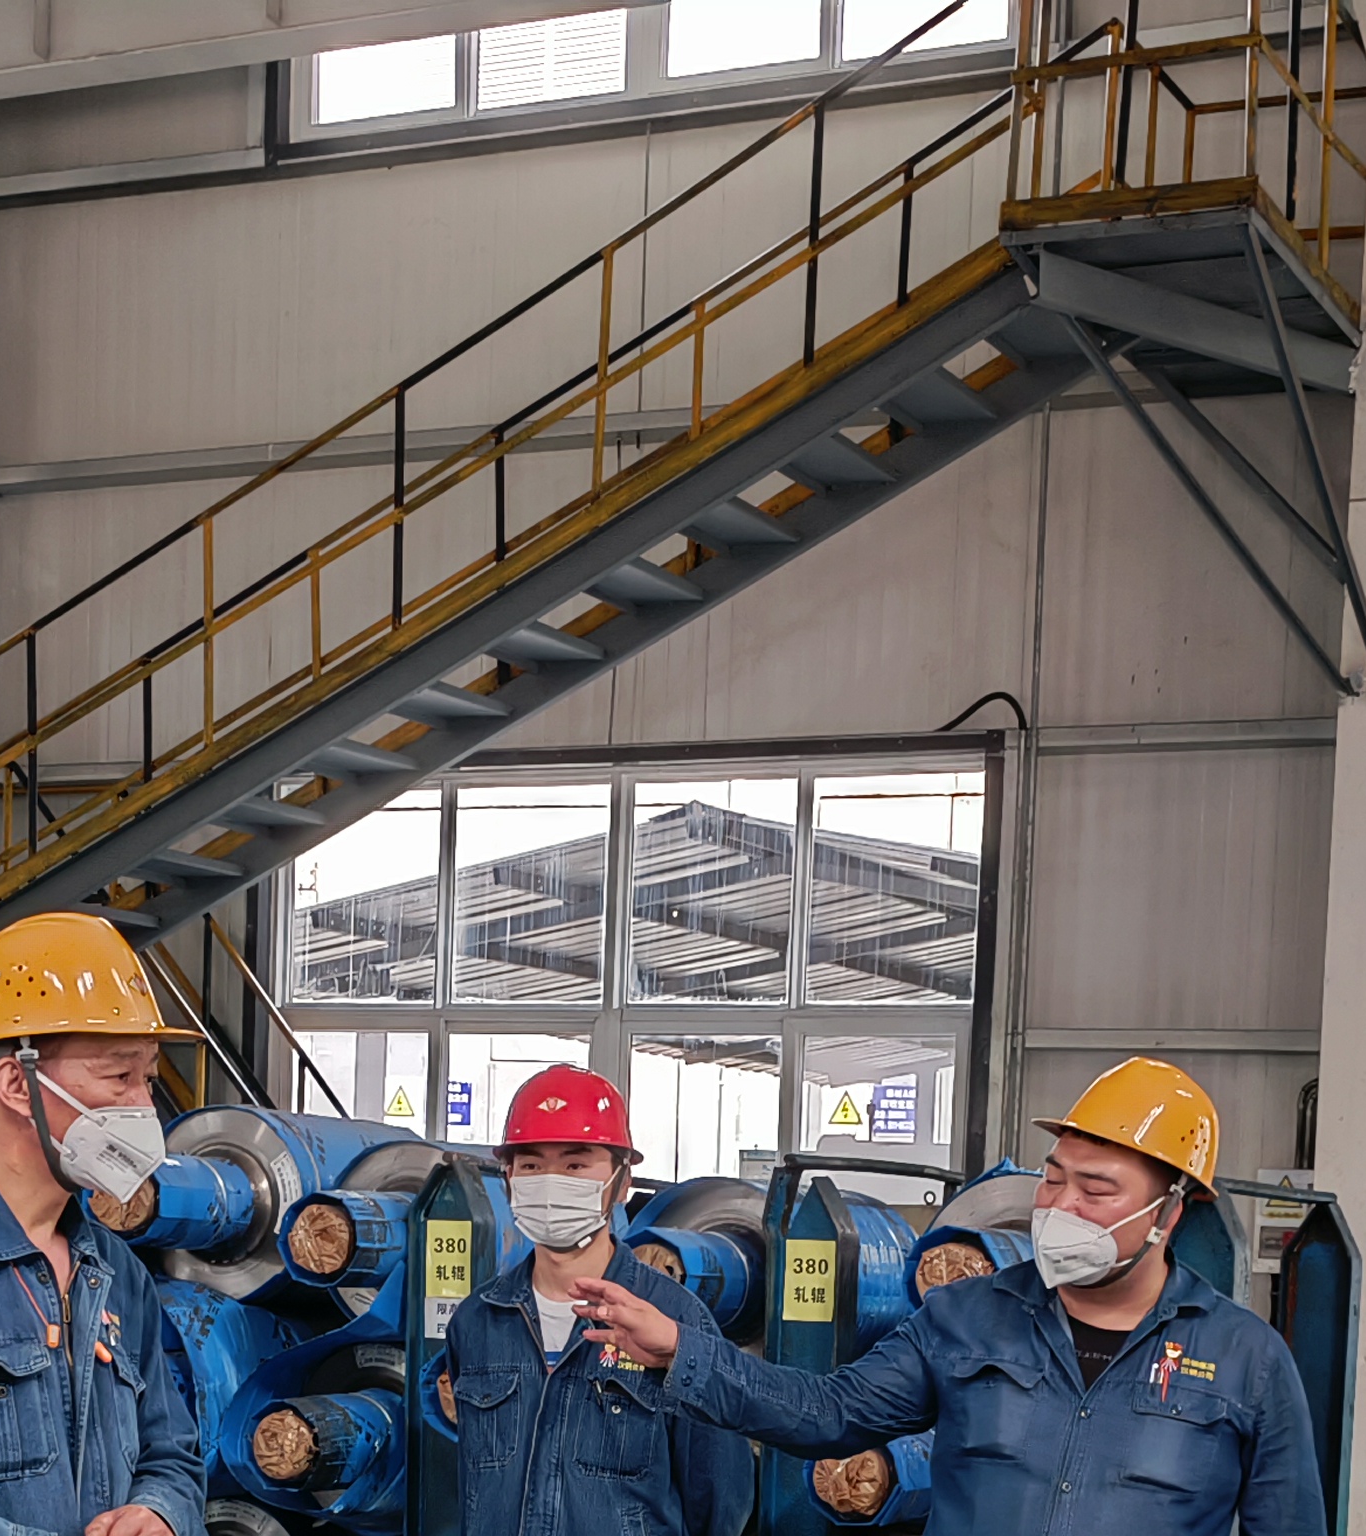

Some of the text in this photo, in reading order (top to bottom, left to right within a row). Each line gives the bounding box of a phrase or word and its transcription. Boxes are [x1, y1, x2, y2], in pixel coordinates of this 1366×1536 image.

[433, 1237, 467, 1253] 380
[435, 1264, 466, 1281] 轧辊
[792, 1257, 829, 1275] 380
[793, 1286, 826, 1303] 轧辊
